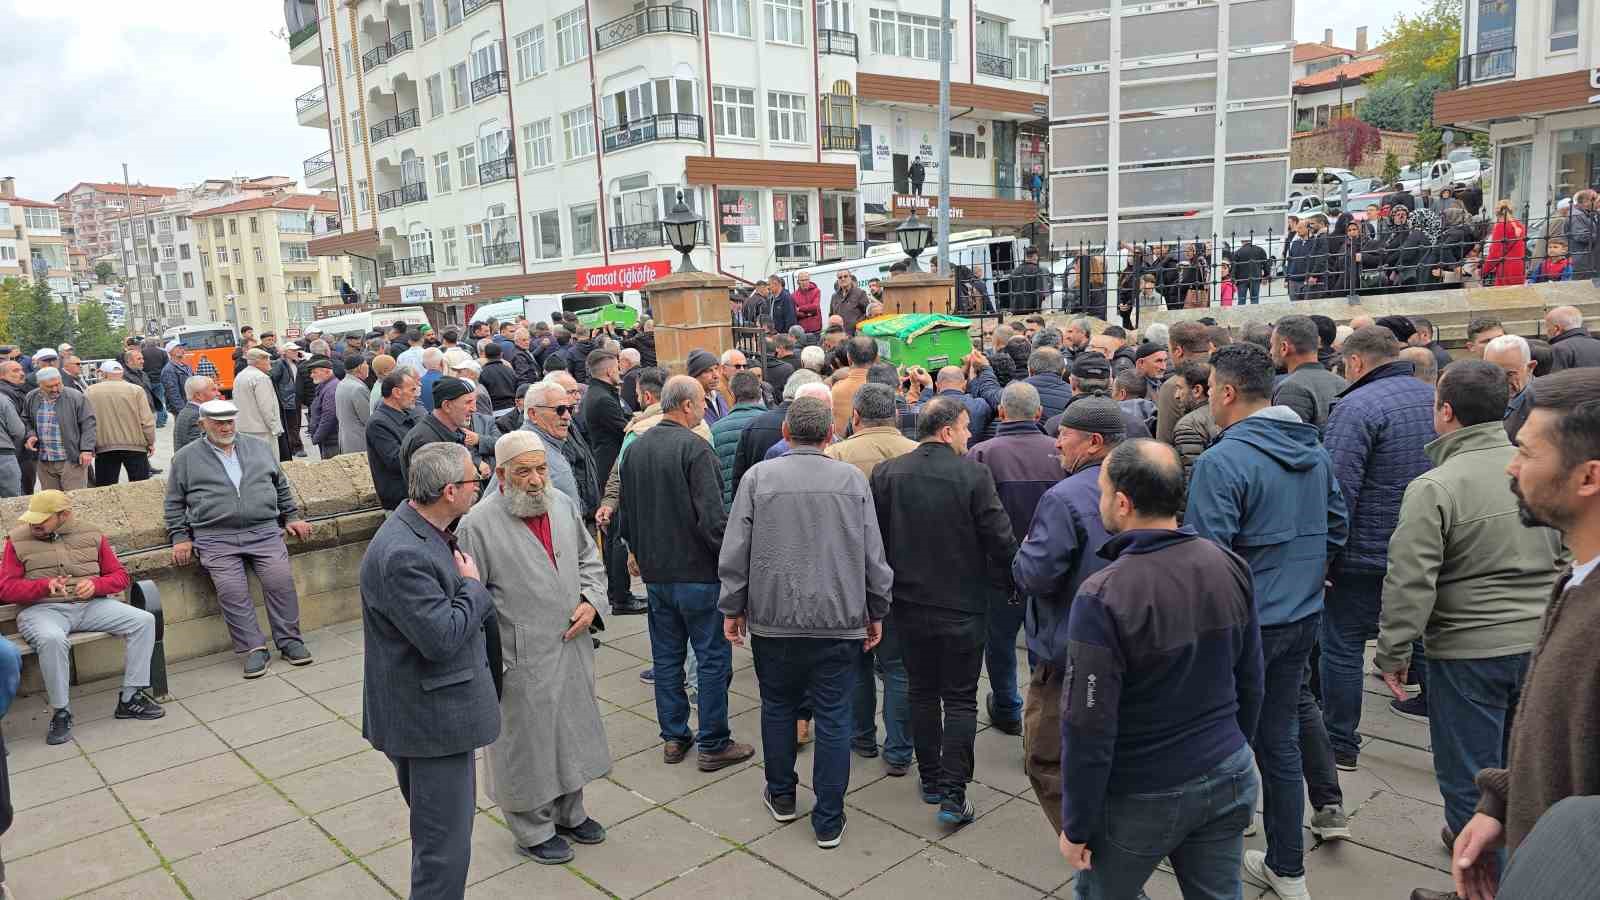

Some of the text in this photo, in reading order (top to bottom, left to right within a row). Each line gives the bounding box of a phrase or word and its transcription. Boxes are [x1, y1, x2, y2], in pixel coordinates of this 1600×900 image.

[927, 206, 963, 218] ZÜCCİYE
[586, 265, 656, 288] Samsat Çiğköfte
